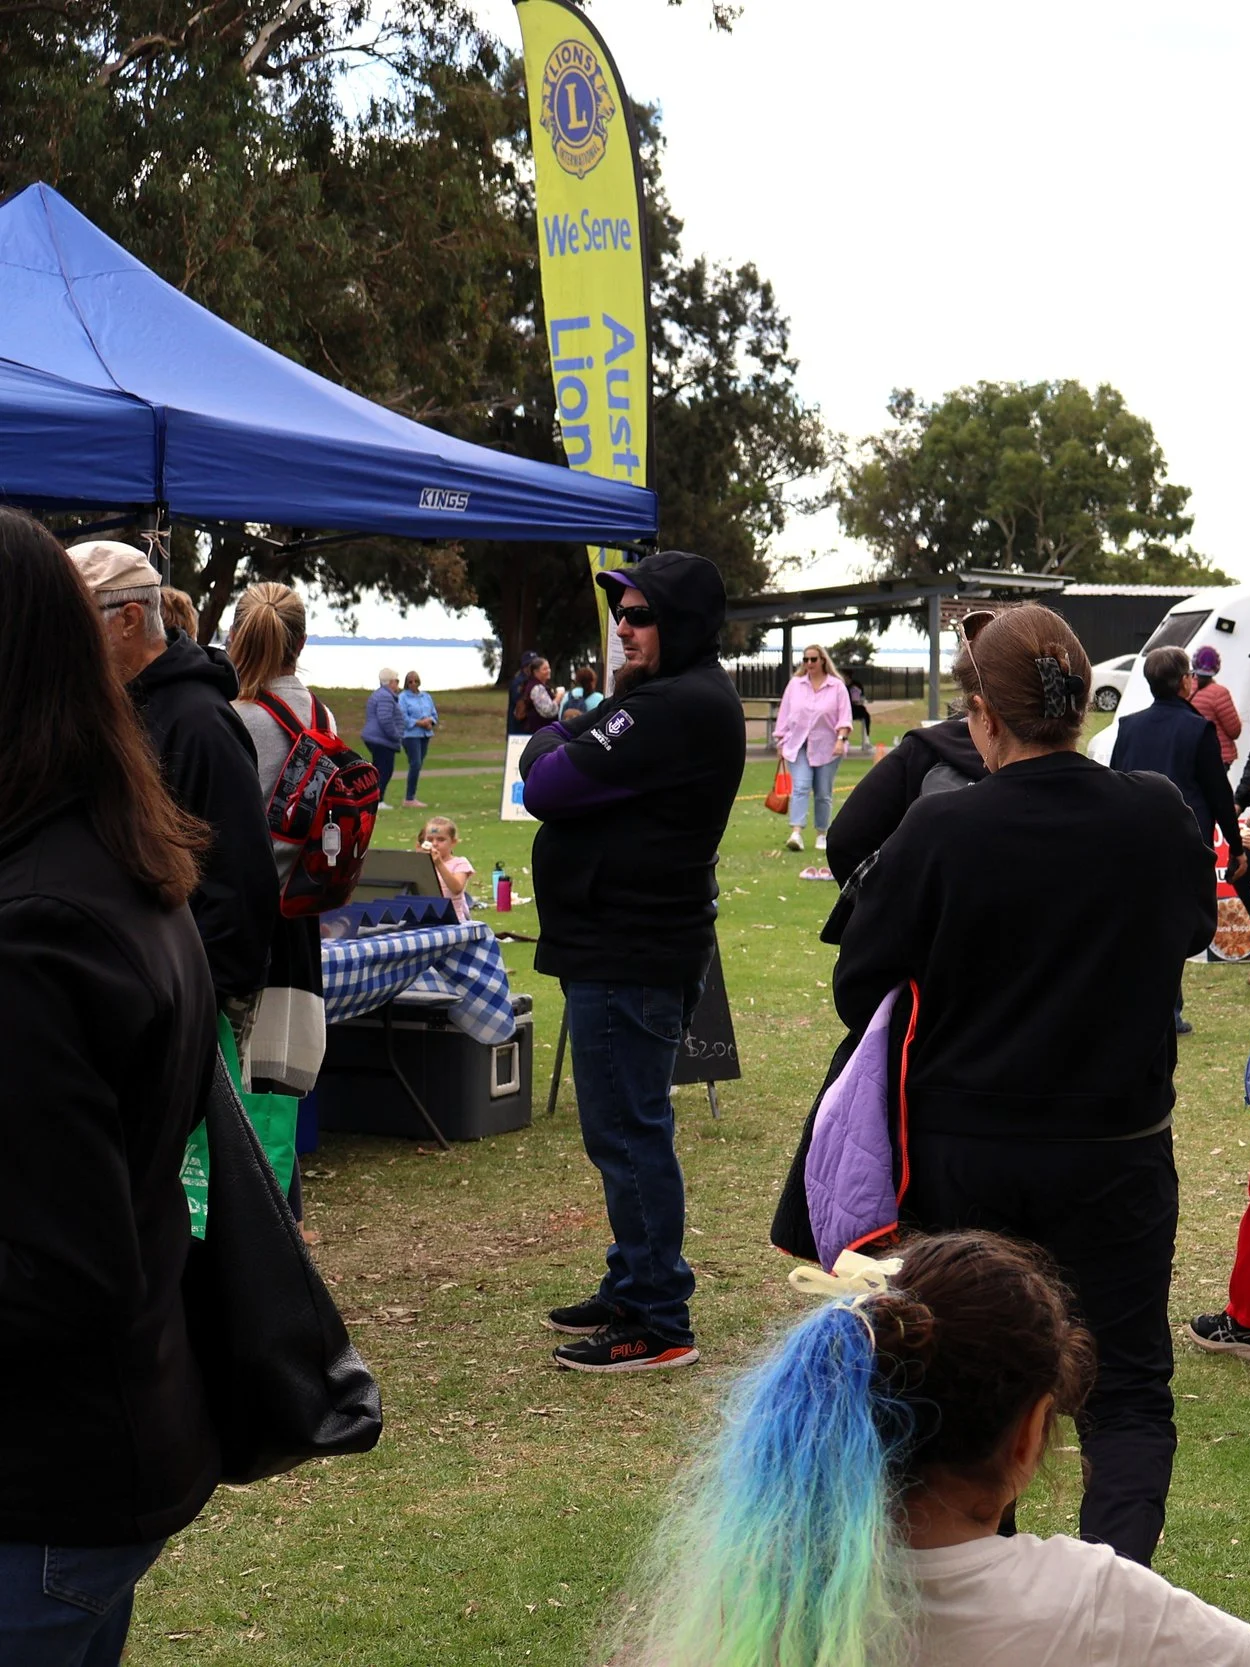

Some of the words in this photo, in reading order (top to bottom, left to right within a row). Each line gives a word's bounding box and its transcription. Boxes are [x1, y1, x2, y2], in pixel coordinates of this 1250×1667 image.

[549, 46, 593, 76] LIONS
[564, 82, 588, 131] L
[543, 213, 580, 257] We
[581, 207, 632, 252] Serve
[550, 315, 595, 475] Lion
[601, 312, 641, 486] Aust
[419, 487, 471, 512] KINGS
[610, 1339, 648, 1360] FILA
